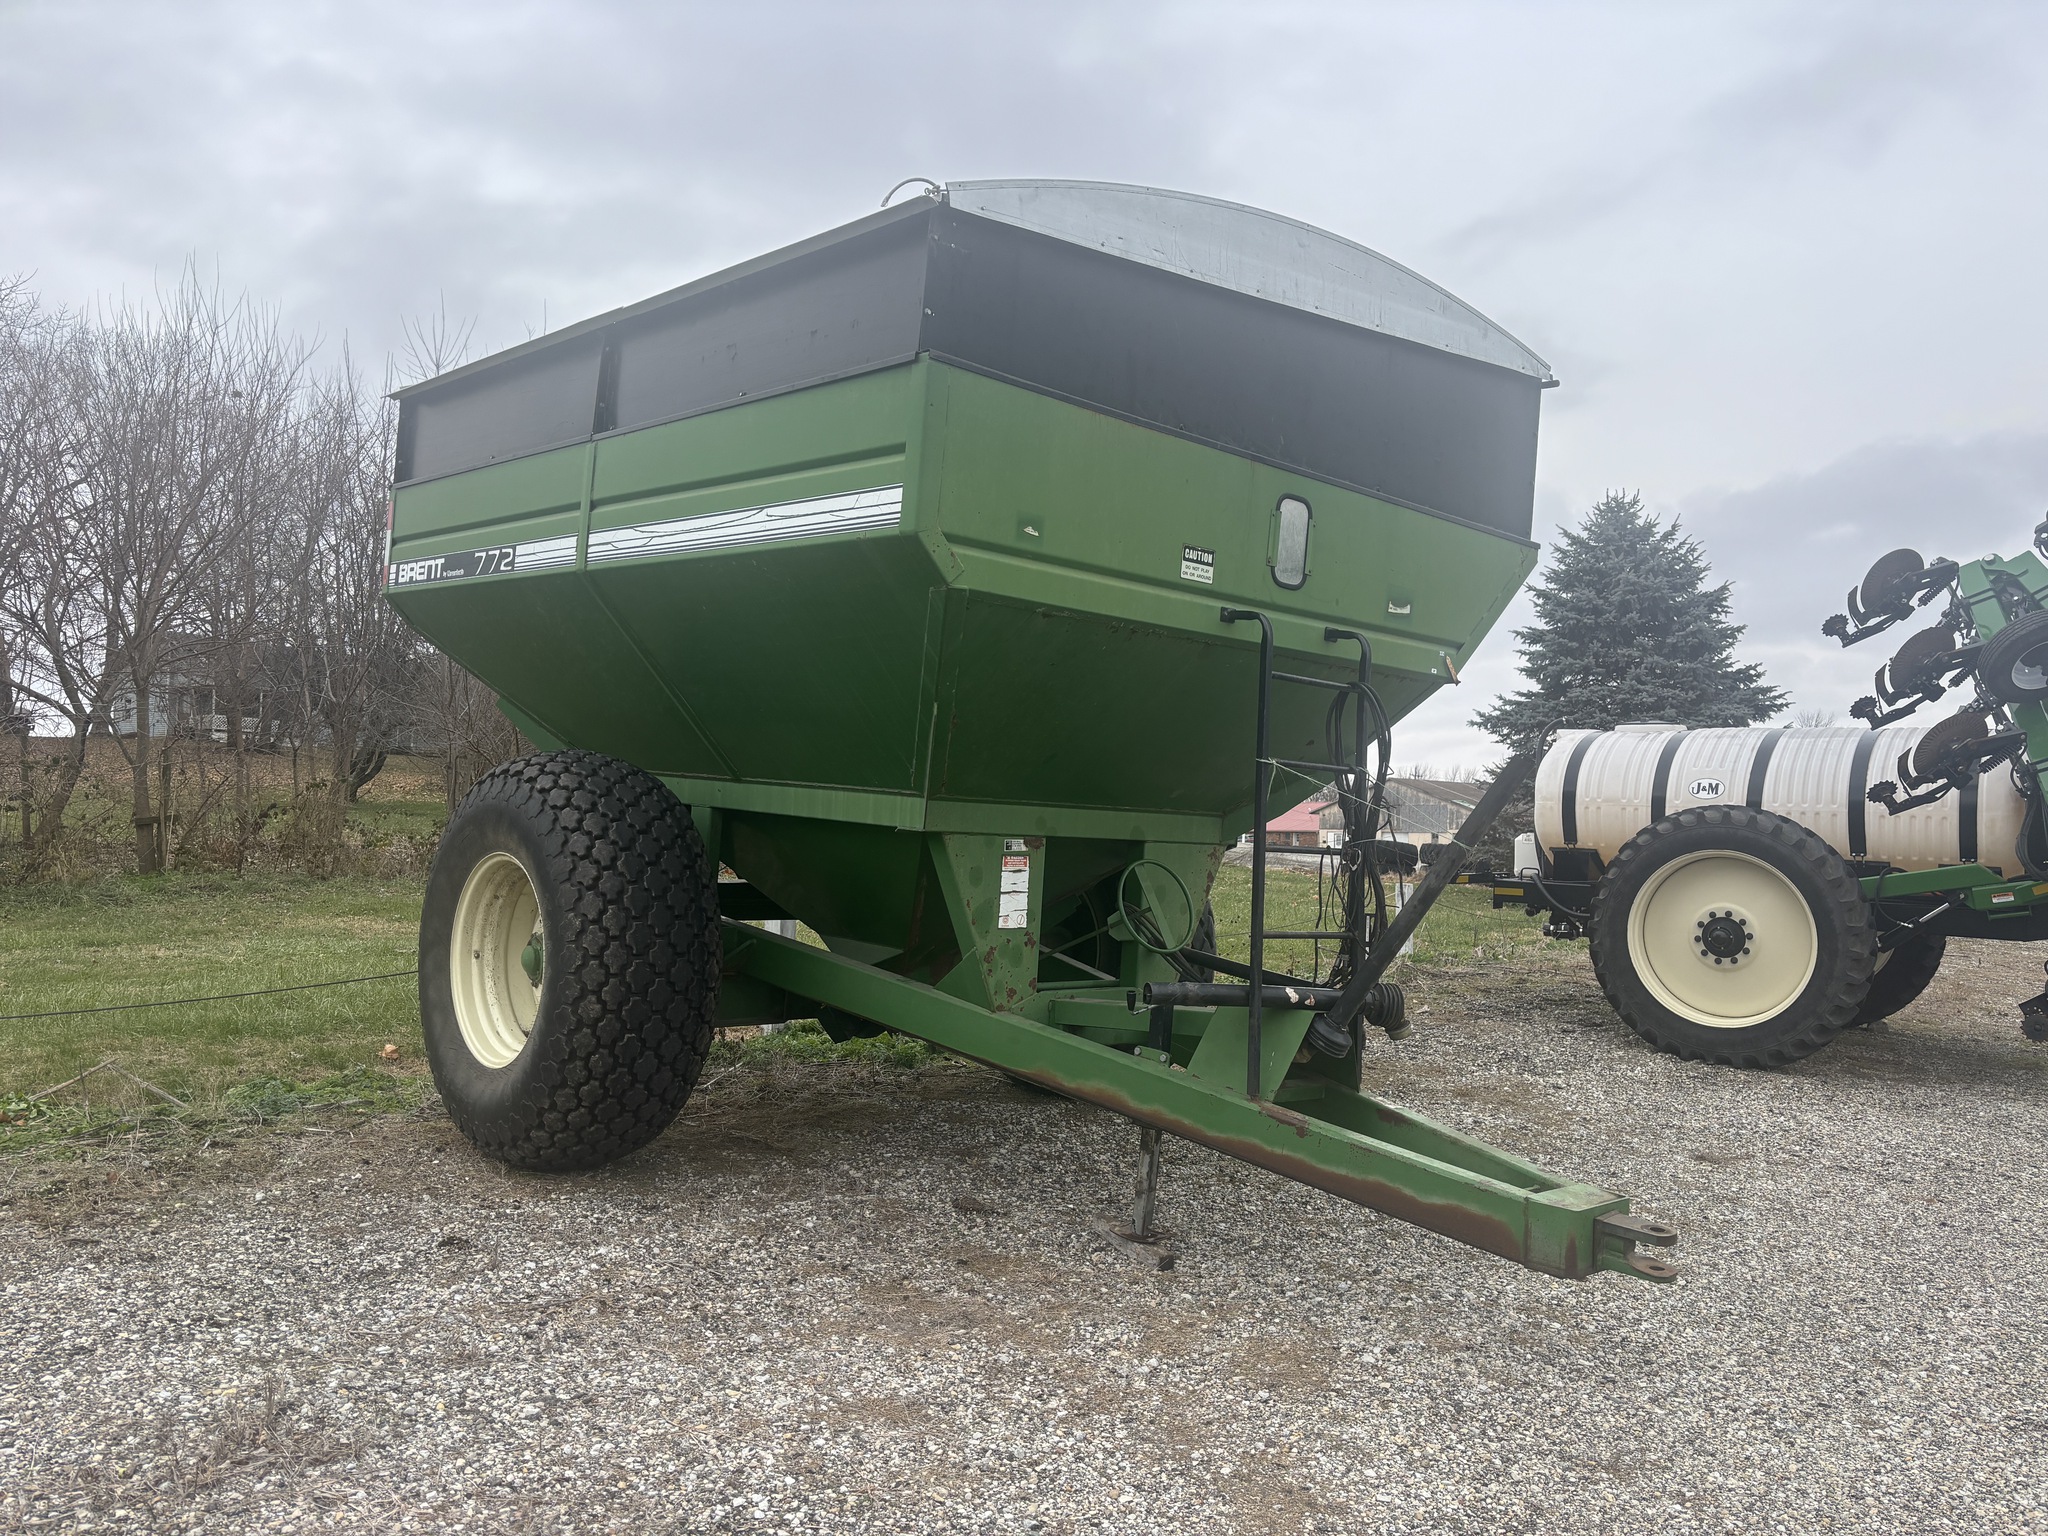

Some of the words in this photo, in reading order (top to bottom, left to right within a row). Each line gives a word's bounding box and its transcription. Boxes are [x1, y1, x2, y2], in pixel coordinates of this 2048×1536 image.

[1185, 549, 1213, 563] CAUTION
[398, 558, 445, 583] BRENT
[474, 548, 514, 576] 772
[1691, 782, 1720, 795] J&M
